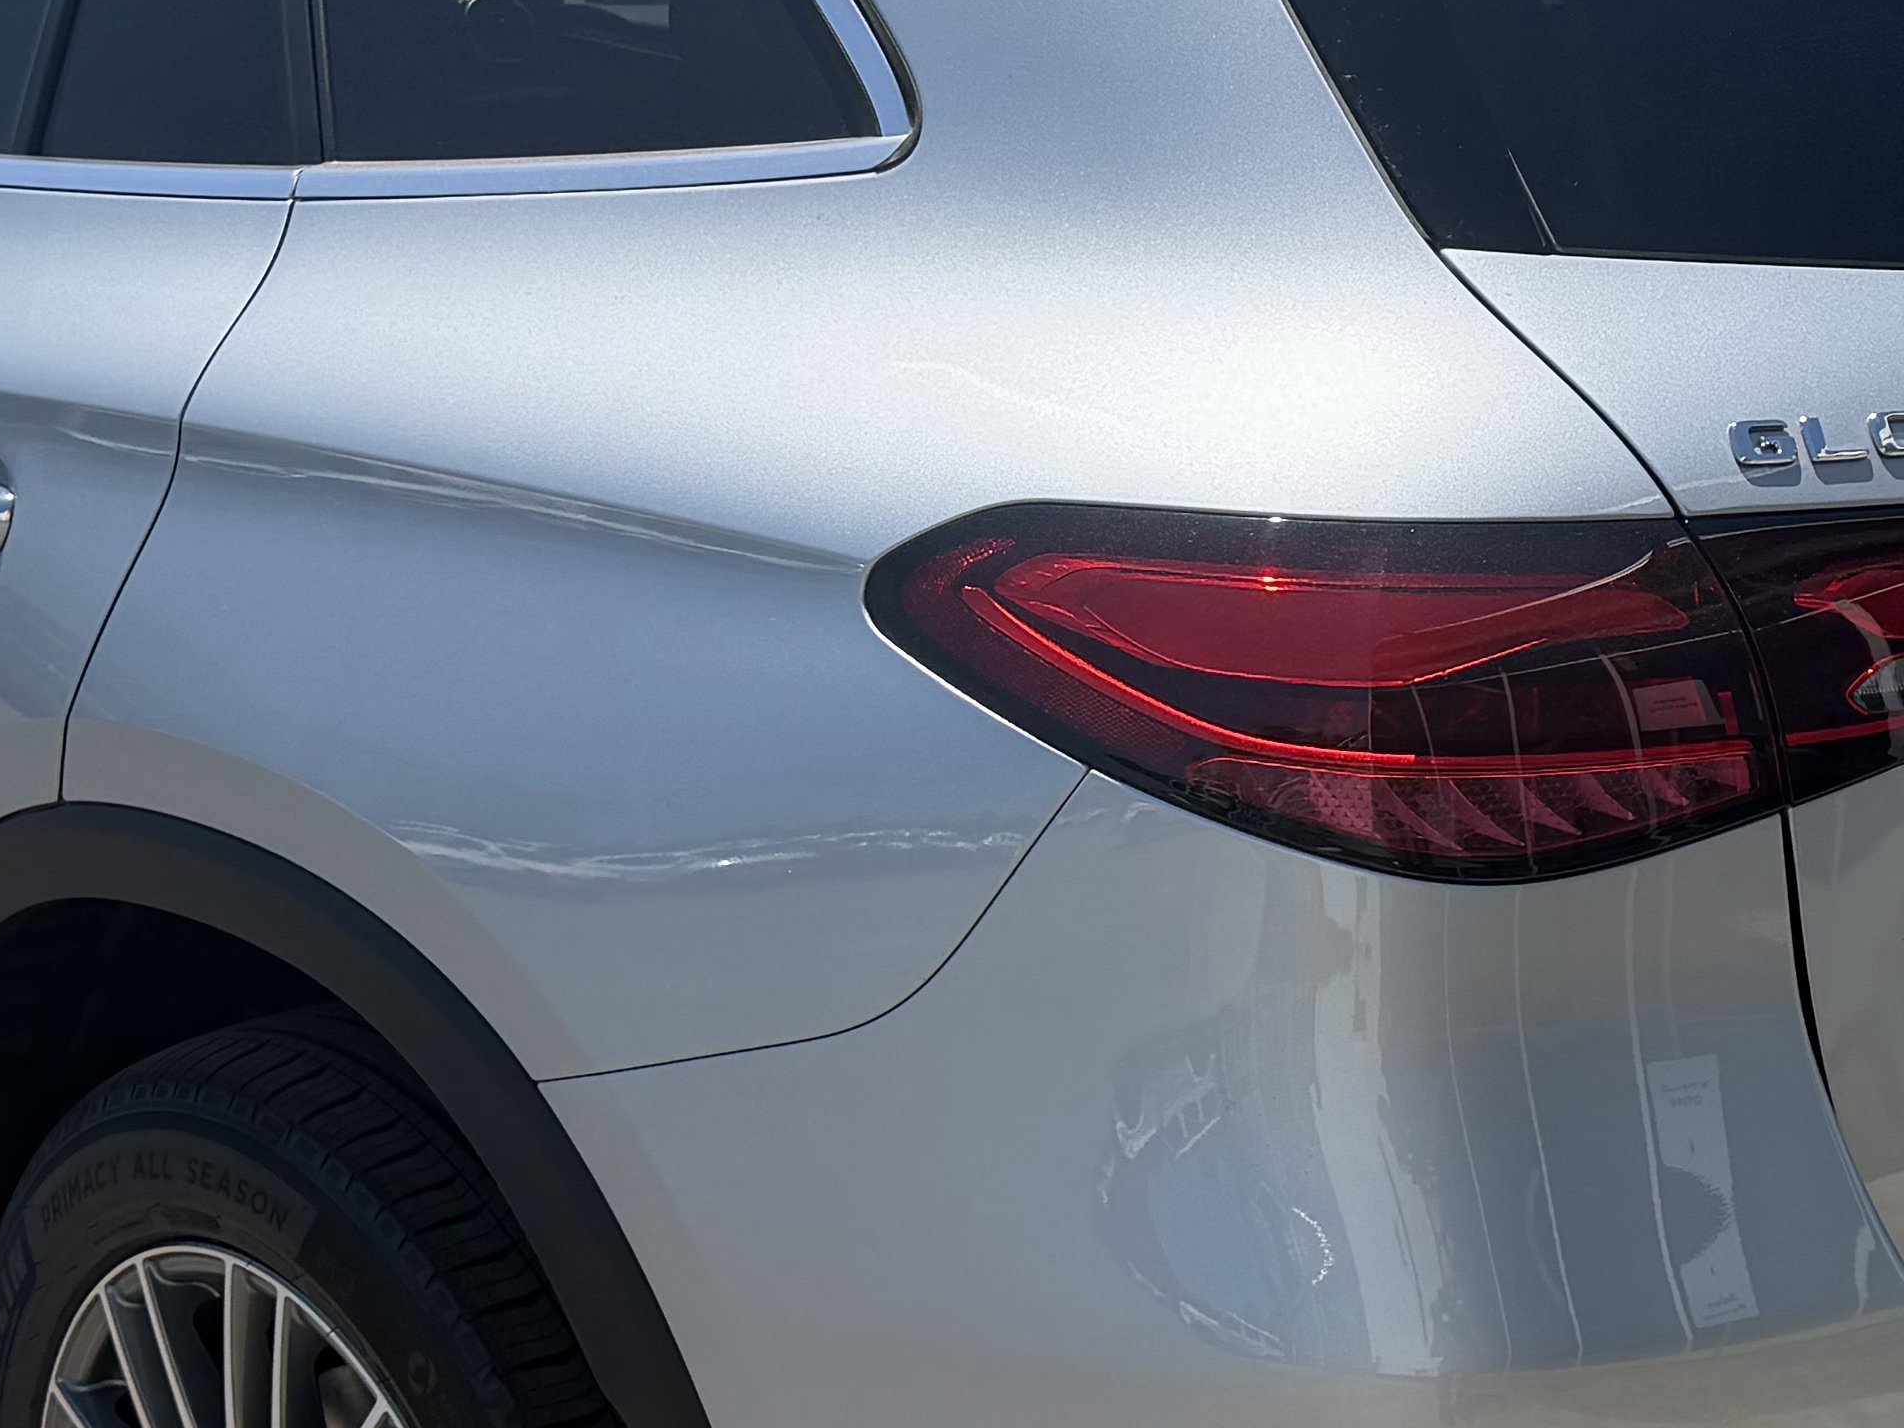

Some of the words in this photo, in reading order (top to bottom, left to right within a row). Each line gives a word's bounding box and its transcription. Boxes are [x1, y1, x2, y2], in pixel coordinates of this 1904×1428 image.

[40, 1154, 122, 1234] PRIMACY
[132, 1148, 175, 1182] ALL
[186, 1156, 291, 1233] SEASON
